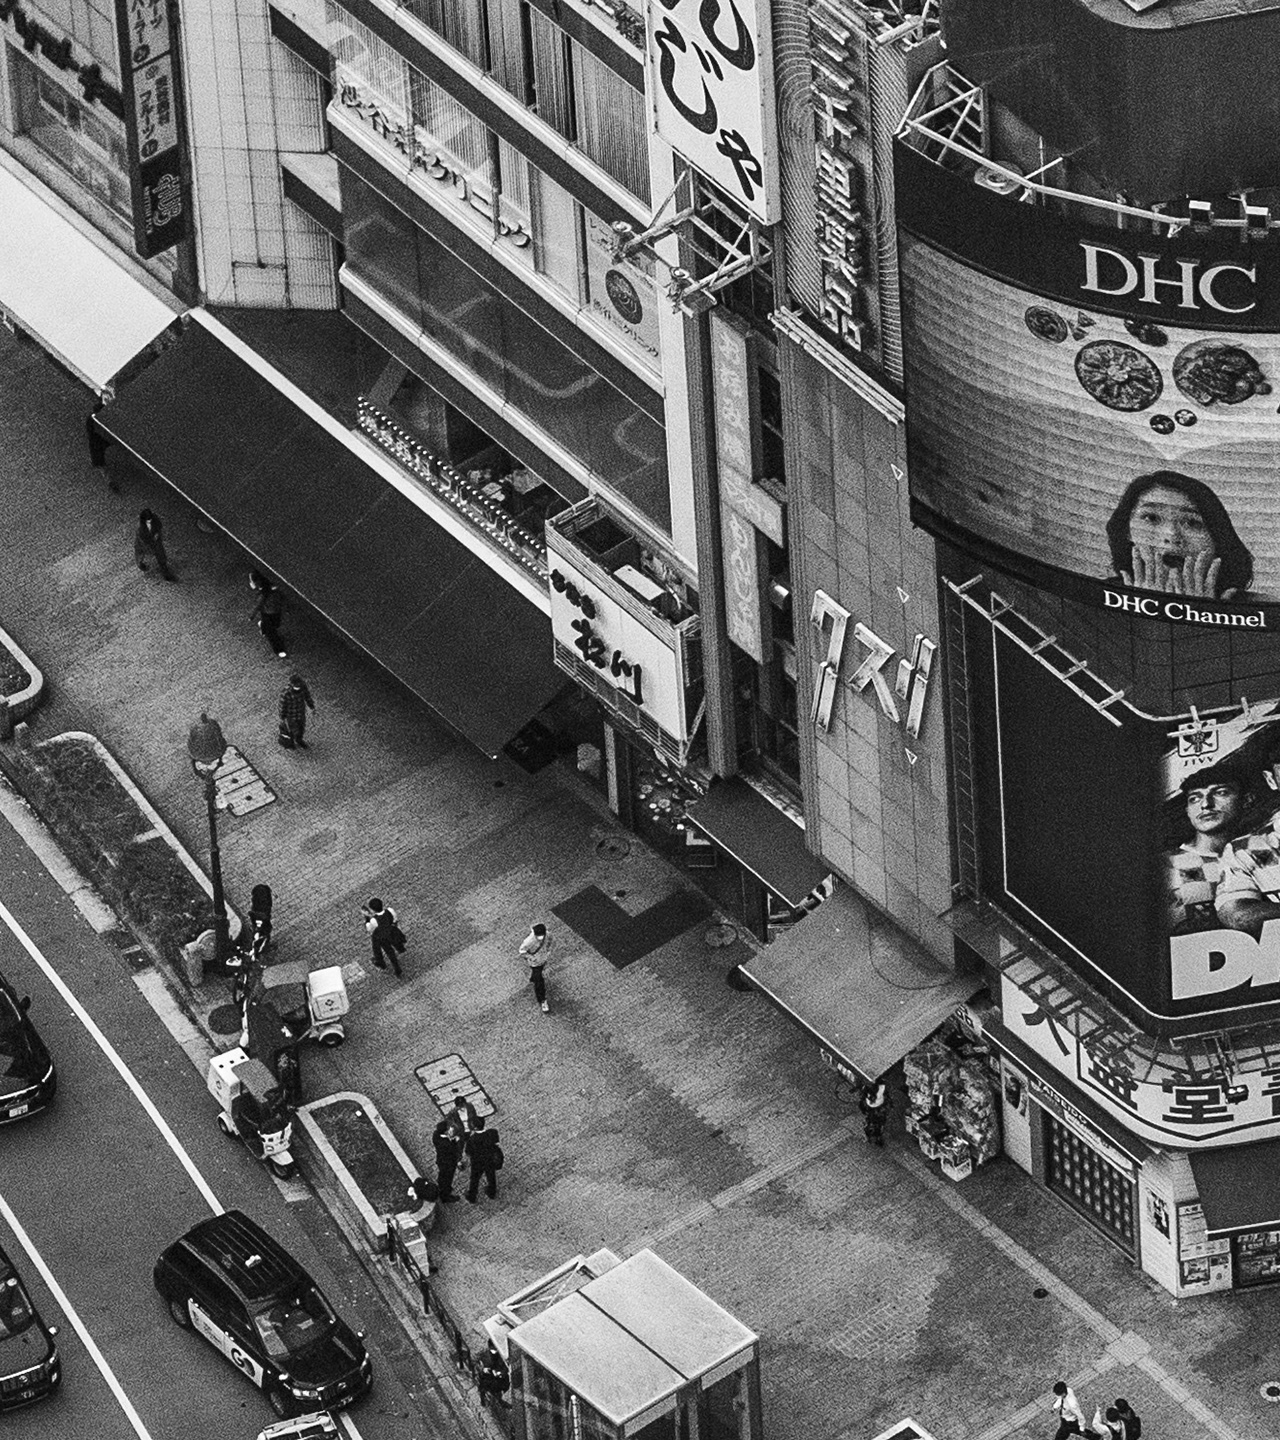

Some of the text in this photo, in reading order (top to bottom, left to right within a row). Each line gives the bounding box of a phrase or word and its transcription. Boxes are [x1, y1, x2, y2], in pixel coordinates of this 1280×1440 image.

[1079, 241, 1257, 313] DHC
[1103, 589, 1266, 628] DHC Channel
